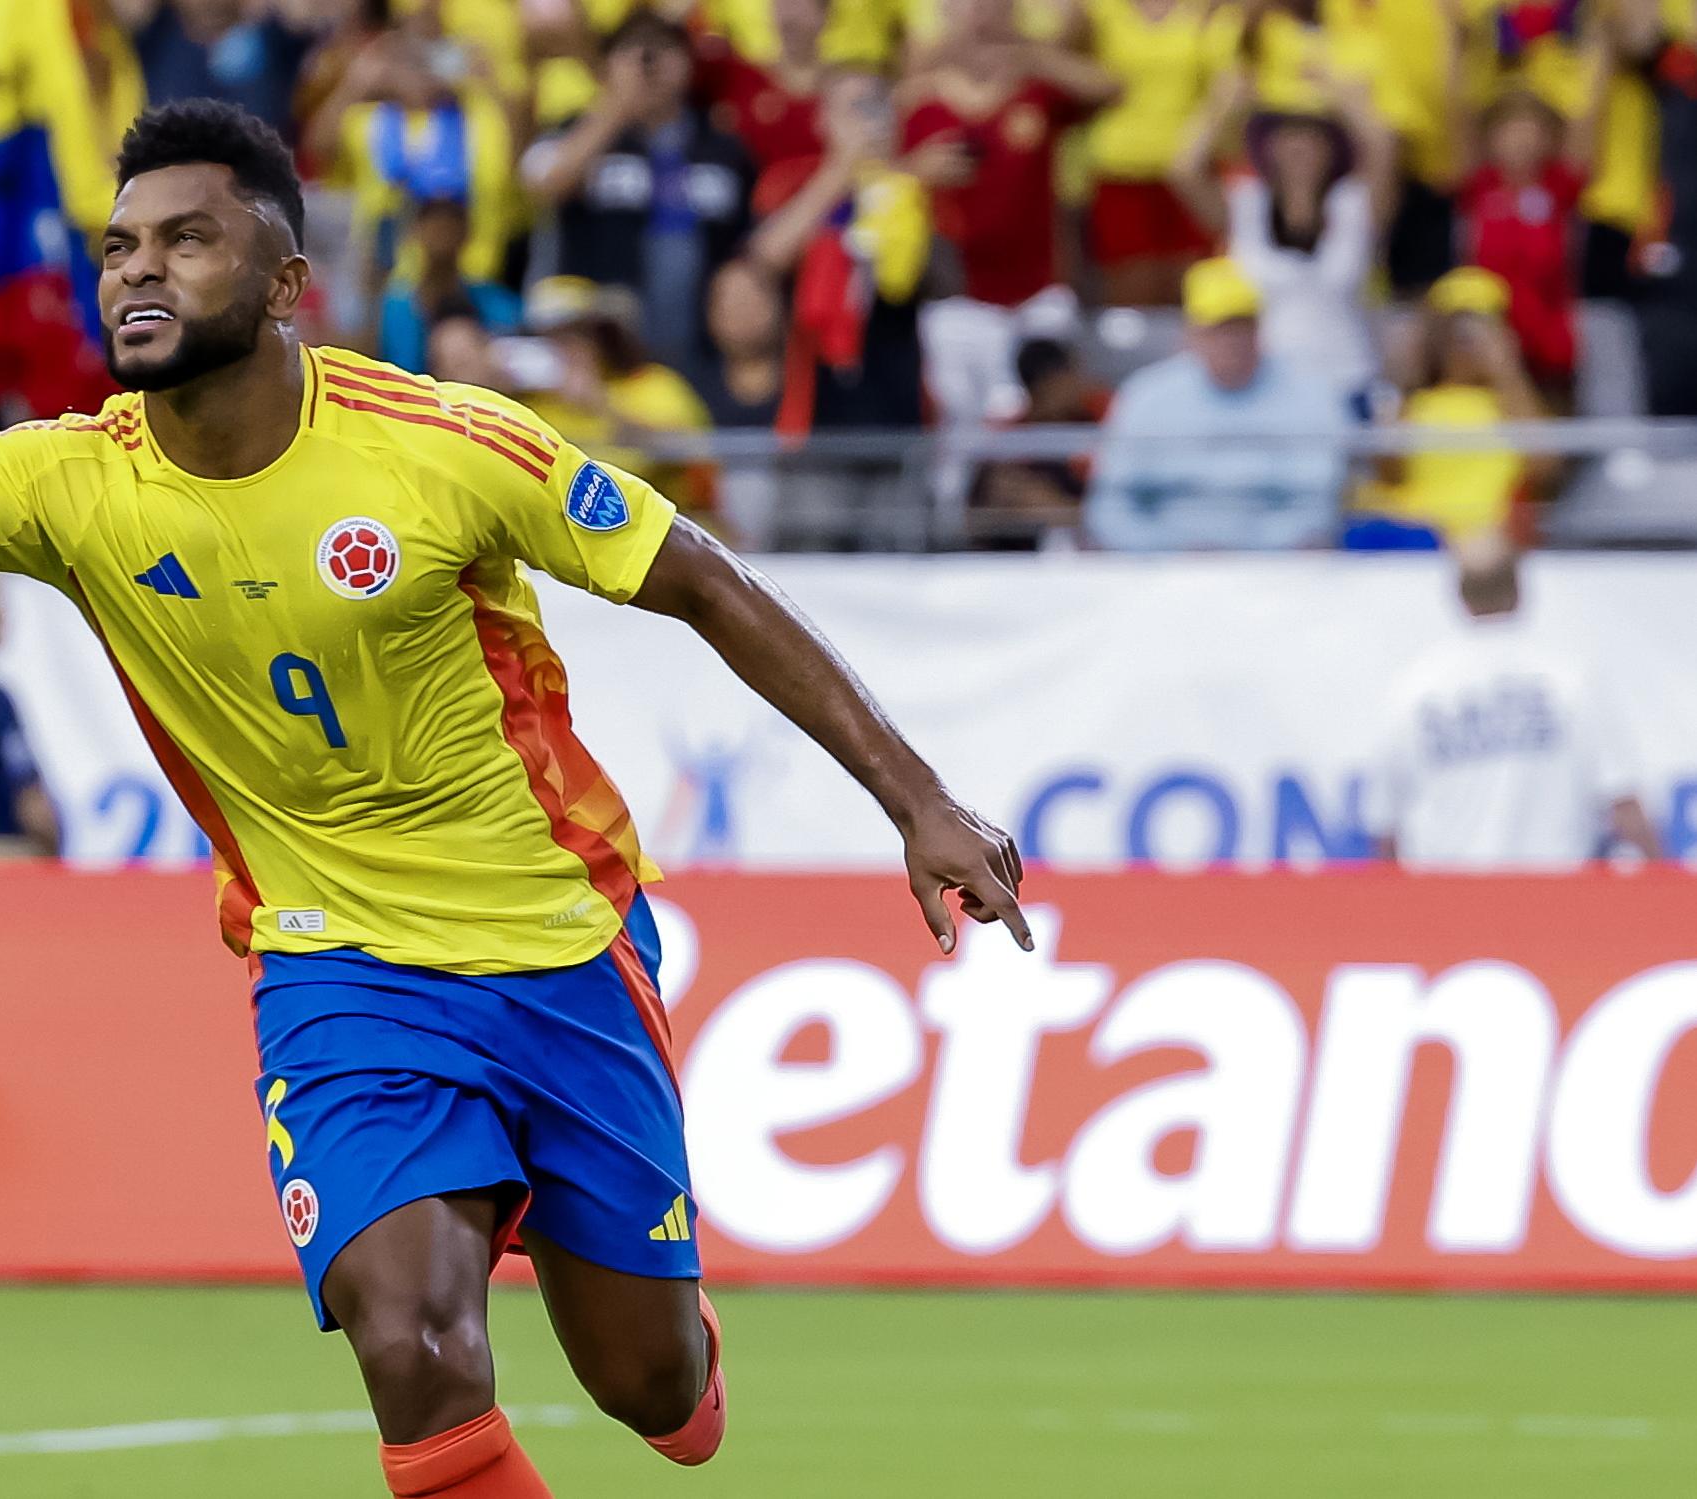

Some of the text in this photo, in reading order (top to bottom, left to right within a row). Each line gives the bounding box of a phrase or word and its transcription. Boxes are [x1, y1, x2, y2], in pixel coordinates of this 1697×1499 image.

[577, 473, 603, 519] VIBRA
[267, 650, 349, 751] 9
[648, 895, 1697, 1258] etano
